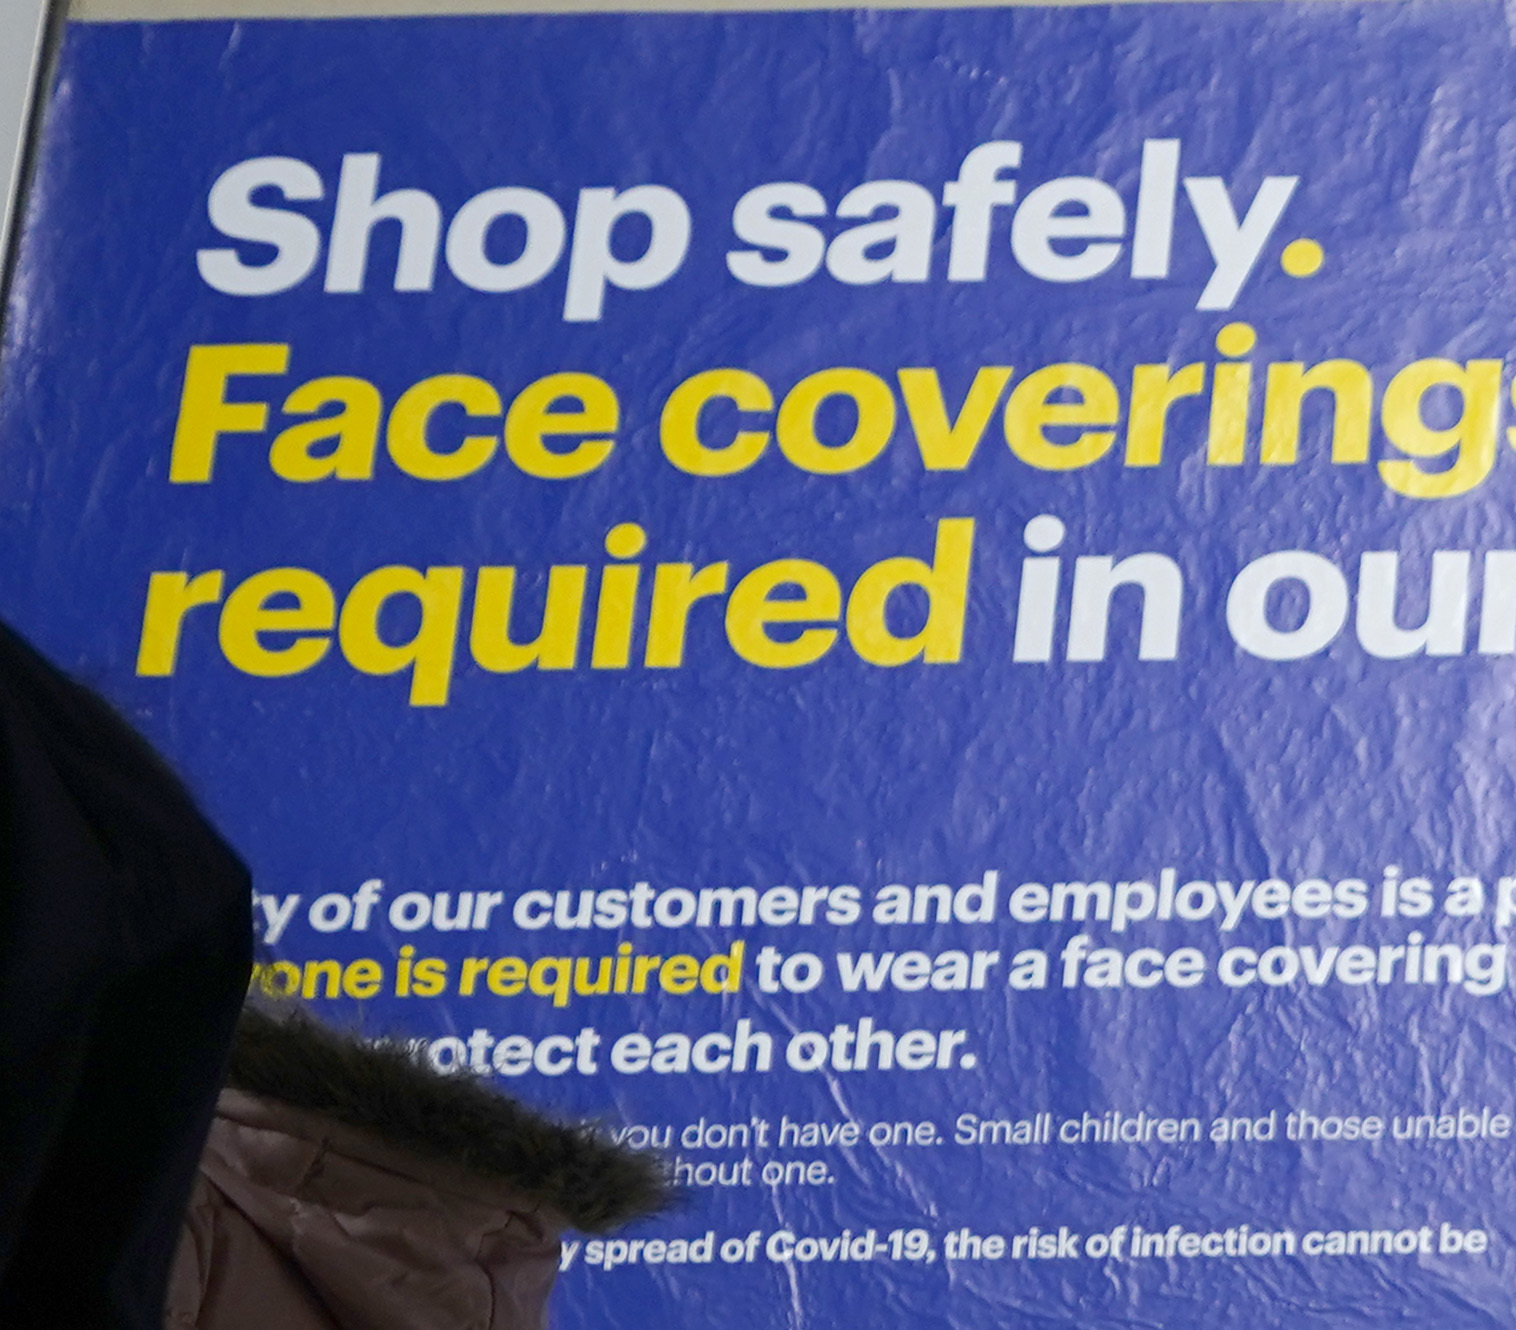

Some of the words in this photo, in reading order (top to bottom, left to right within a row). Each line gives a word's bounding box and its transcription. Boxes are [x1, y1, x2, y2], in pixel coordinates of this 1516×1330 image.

[196, 153, 692, 322] Shop
[725, 137, 1325, 310] safely.
[168, 342, 622, 484] Face
[135, 516, 975, 707] required
[1013, 514, 1184, 663] in
[308, 878, 384, 932] of
[389, 890, 504, 932] our
[513, 880, 860, 930] customers
[871, 868, 999, 925] and
[1008, 867, 1369, 931] employees
[1381, 865, 1434, 916] is
[1444, 872, 1485, 915] a
[395, 944, 447, 998] is
[459, 940, 745, 1008] required
[755, 945, 824, 994] to
[837, 945, 1000, 991] wear
[1008, 948, 1047, 989] a
[1061, 934, 1206, 988] face
[1217, 931, 1509, 996] covering
[363, 1027, 602, 1077] otect
[610, 1018, 771, 1075] each
[785, 1016, 977, 1071] other.
[680, 1116, 770, 1150] don't
[778, 1114, 861, 1148] have
[868, 1119, 944, 1147] one.
[953, 1112, 1050, 1145] Small
[1058, 1110, 1202, 1144] children
[1209, 1109, 1279, 1143] and
[1284, 1109, 1386, 1141] those
[1391, 1107, 1512, 1141] unable
[661, 1155, 753, 1187] hout
[761, 1160, 836, 1186] one.
[584, 1230, 715, 1271] spread
[719, 1230, 762, 1264] of
[766, 1227, 937, 1264] Covid-19,
[943, 1226, 1004, 1260] the
[1010, 1226, 1079, 1259] risk
[1085, 1224, 1127, 1258] of
[1129, 1222, 1295, 1258] infection
[1301, 1224, 1433, 1257] cannot
[1438, 1222, 1488, 1255] be
